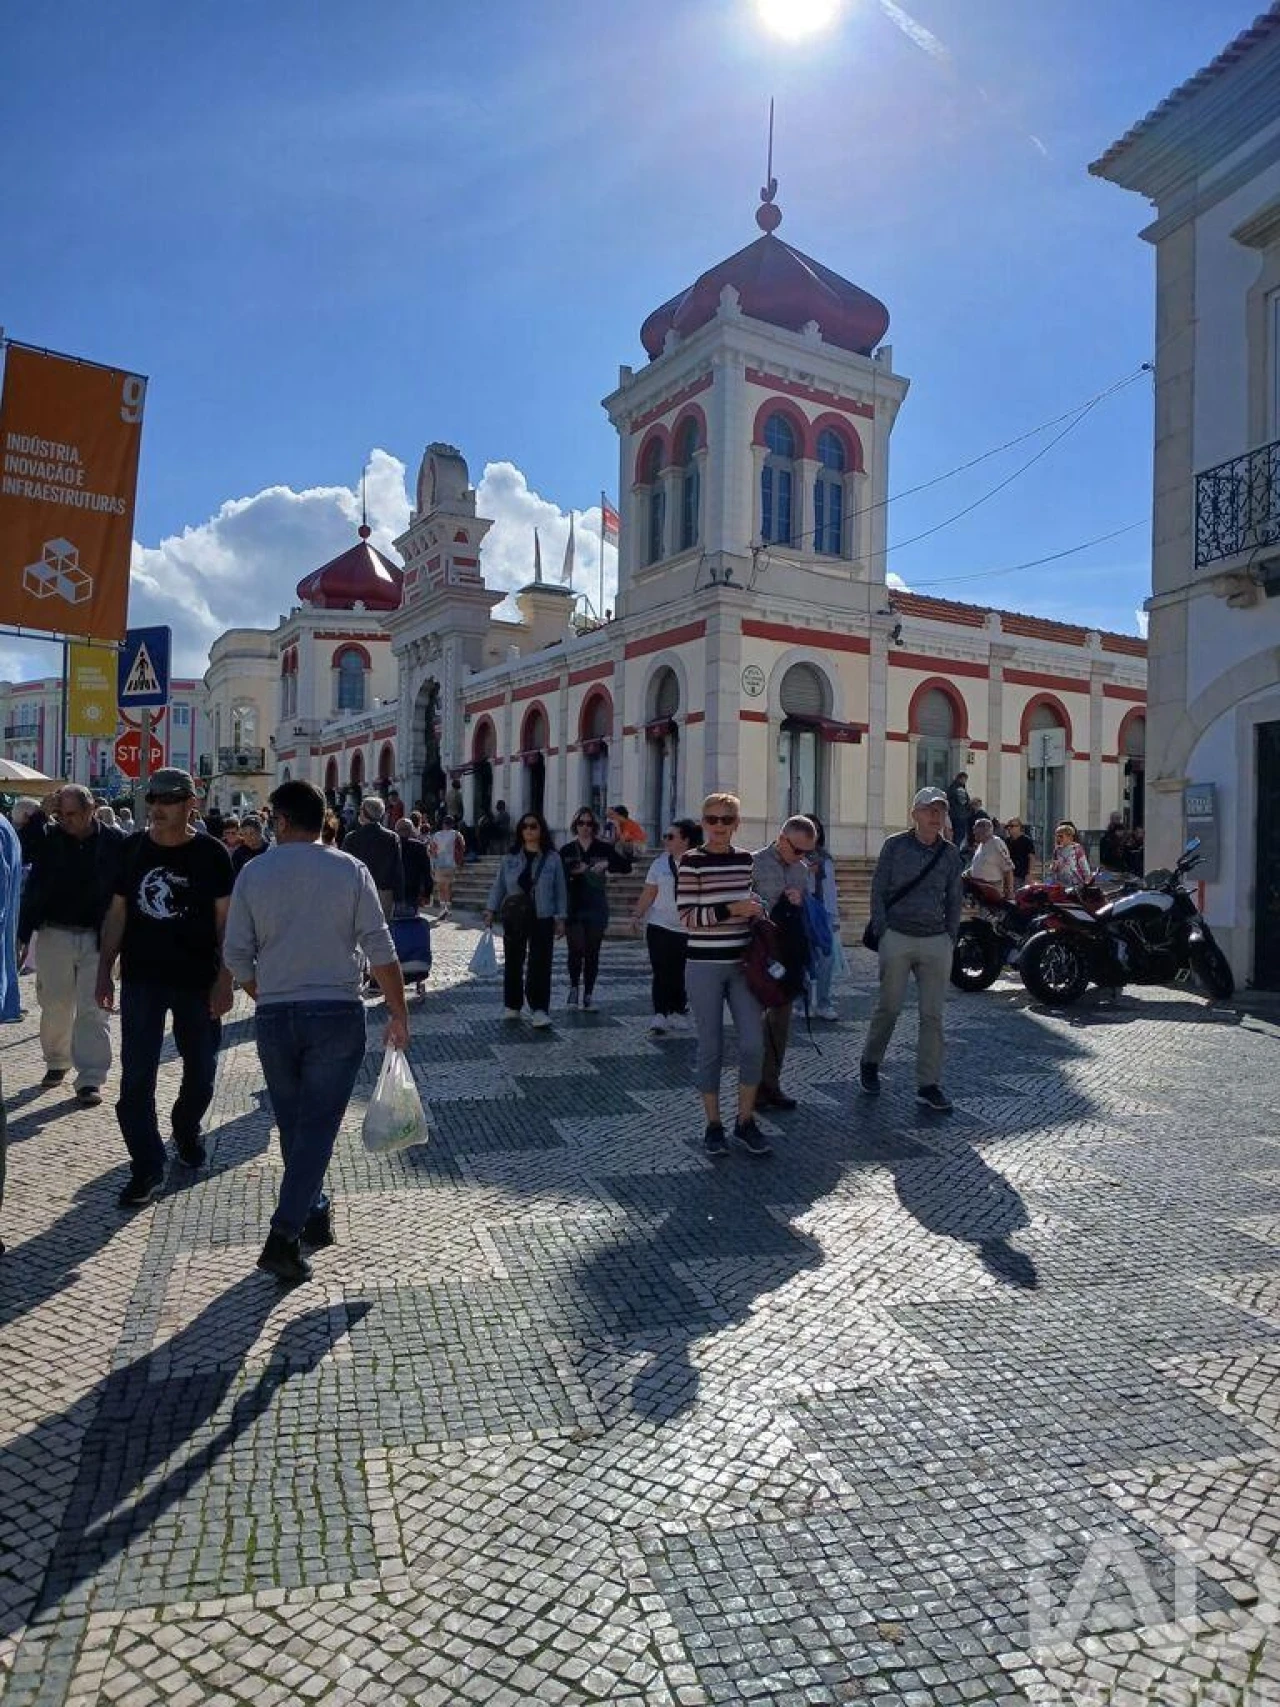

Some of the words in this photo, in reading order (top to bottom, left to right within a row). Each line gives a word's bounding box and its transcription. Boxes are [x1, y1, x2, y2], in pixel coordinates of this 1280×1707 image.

[121, 376, 145, 423] 9
[4, 453, 74, 485] INOVAÇÃO
[76, 468, 86, 487] E
[3, 475, 126, 515] INFRAESTRUTURAS
[118, 745, 161, 763] STP
